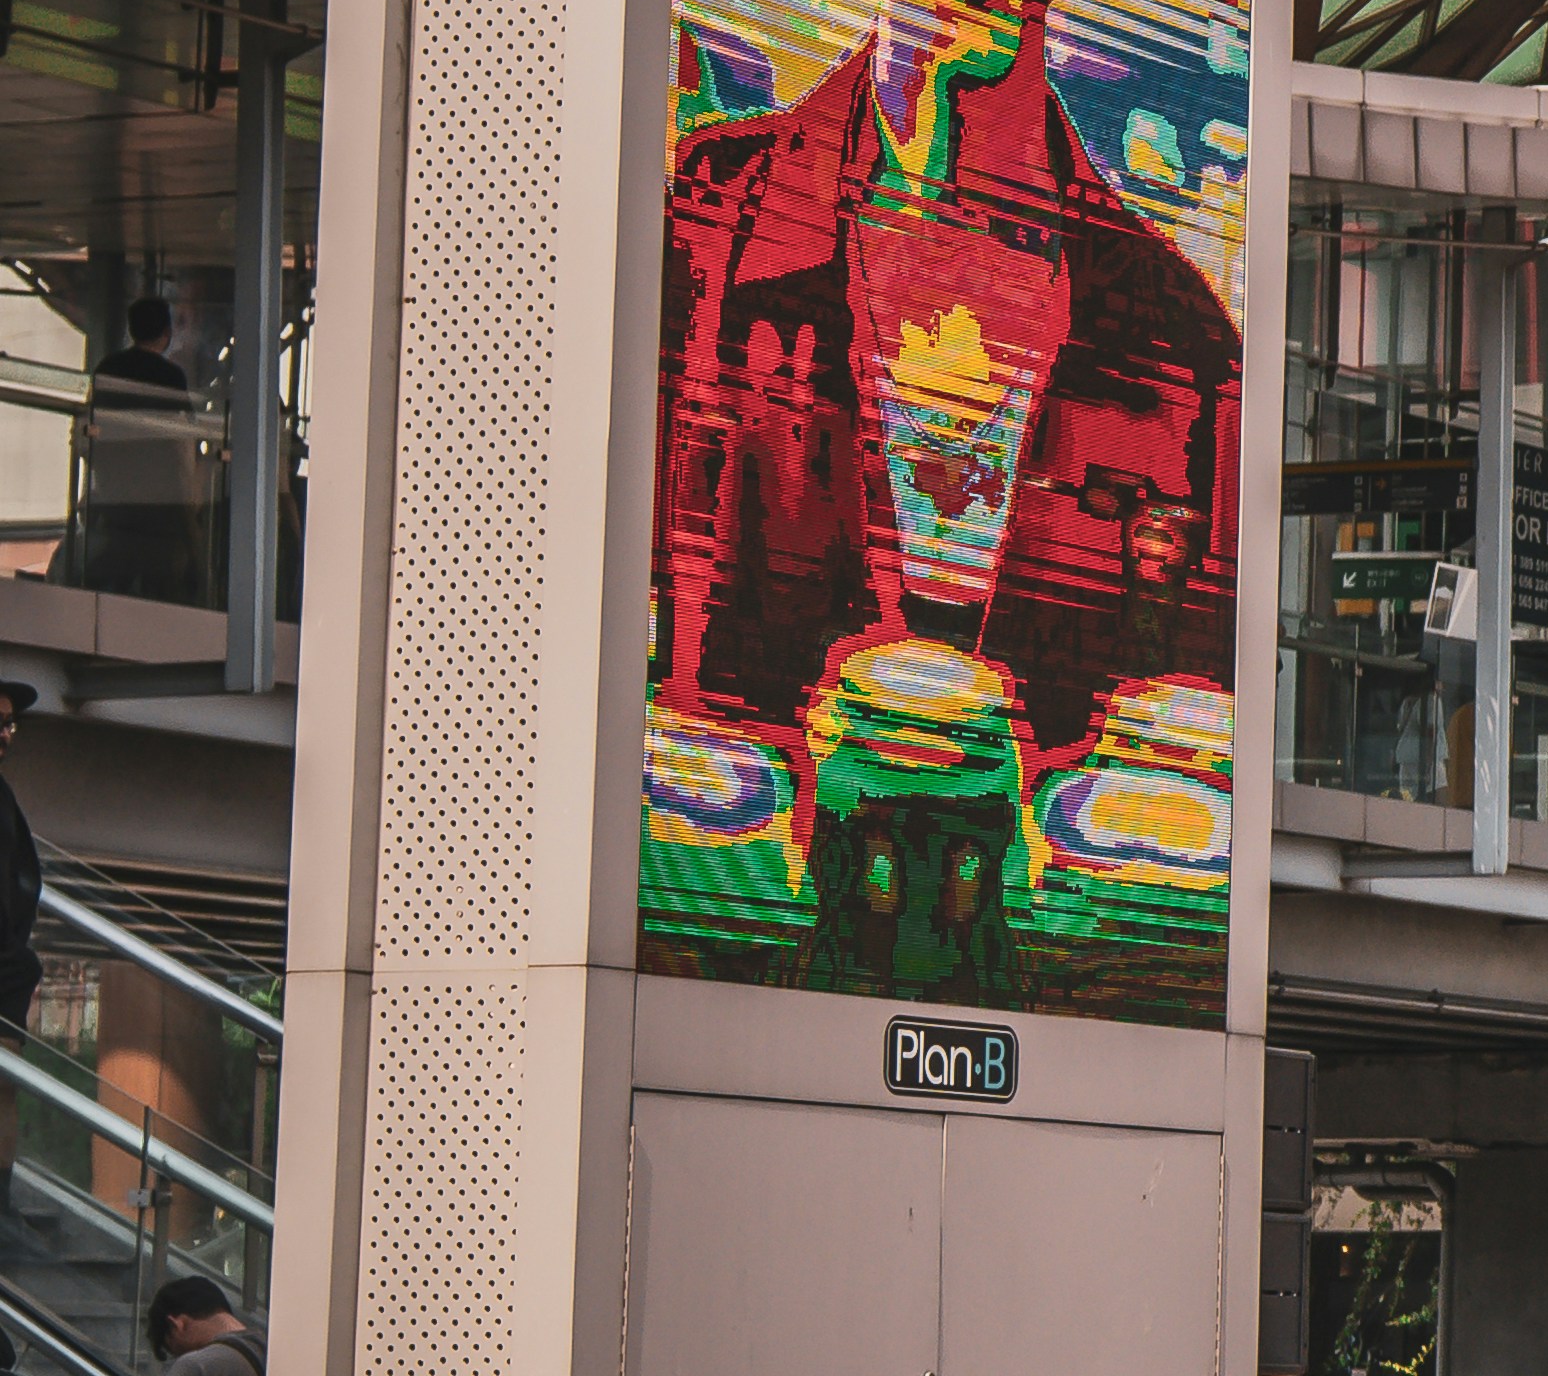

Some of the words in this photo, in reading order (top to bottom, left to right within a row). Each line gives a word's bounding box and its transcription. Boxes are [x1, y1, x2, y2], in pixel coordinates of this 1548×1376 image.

[1516, 449, 1542, 474] IER
[1514, 485, 1548, 510] FFICE
[1514, 514, 1541, 544] OR
